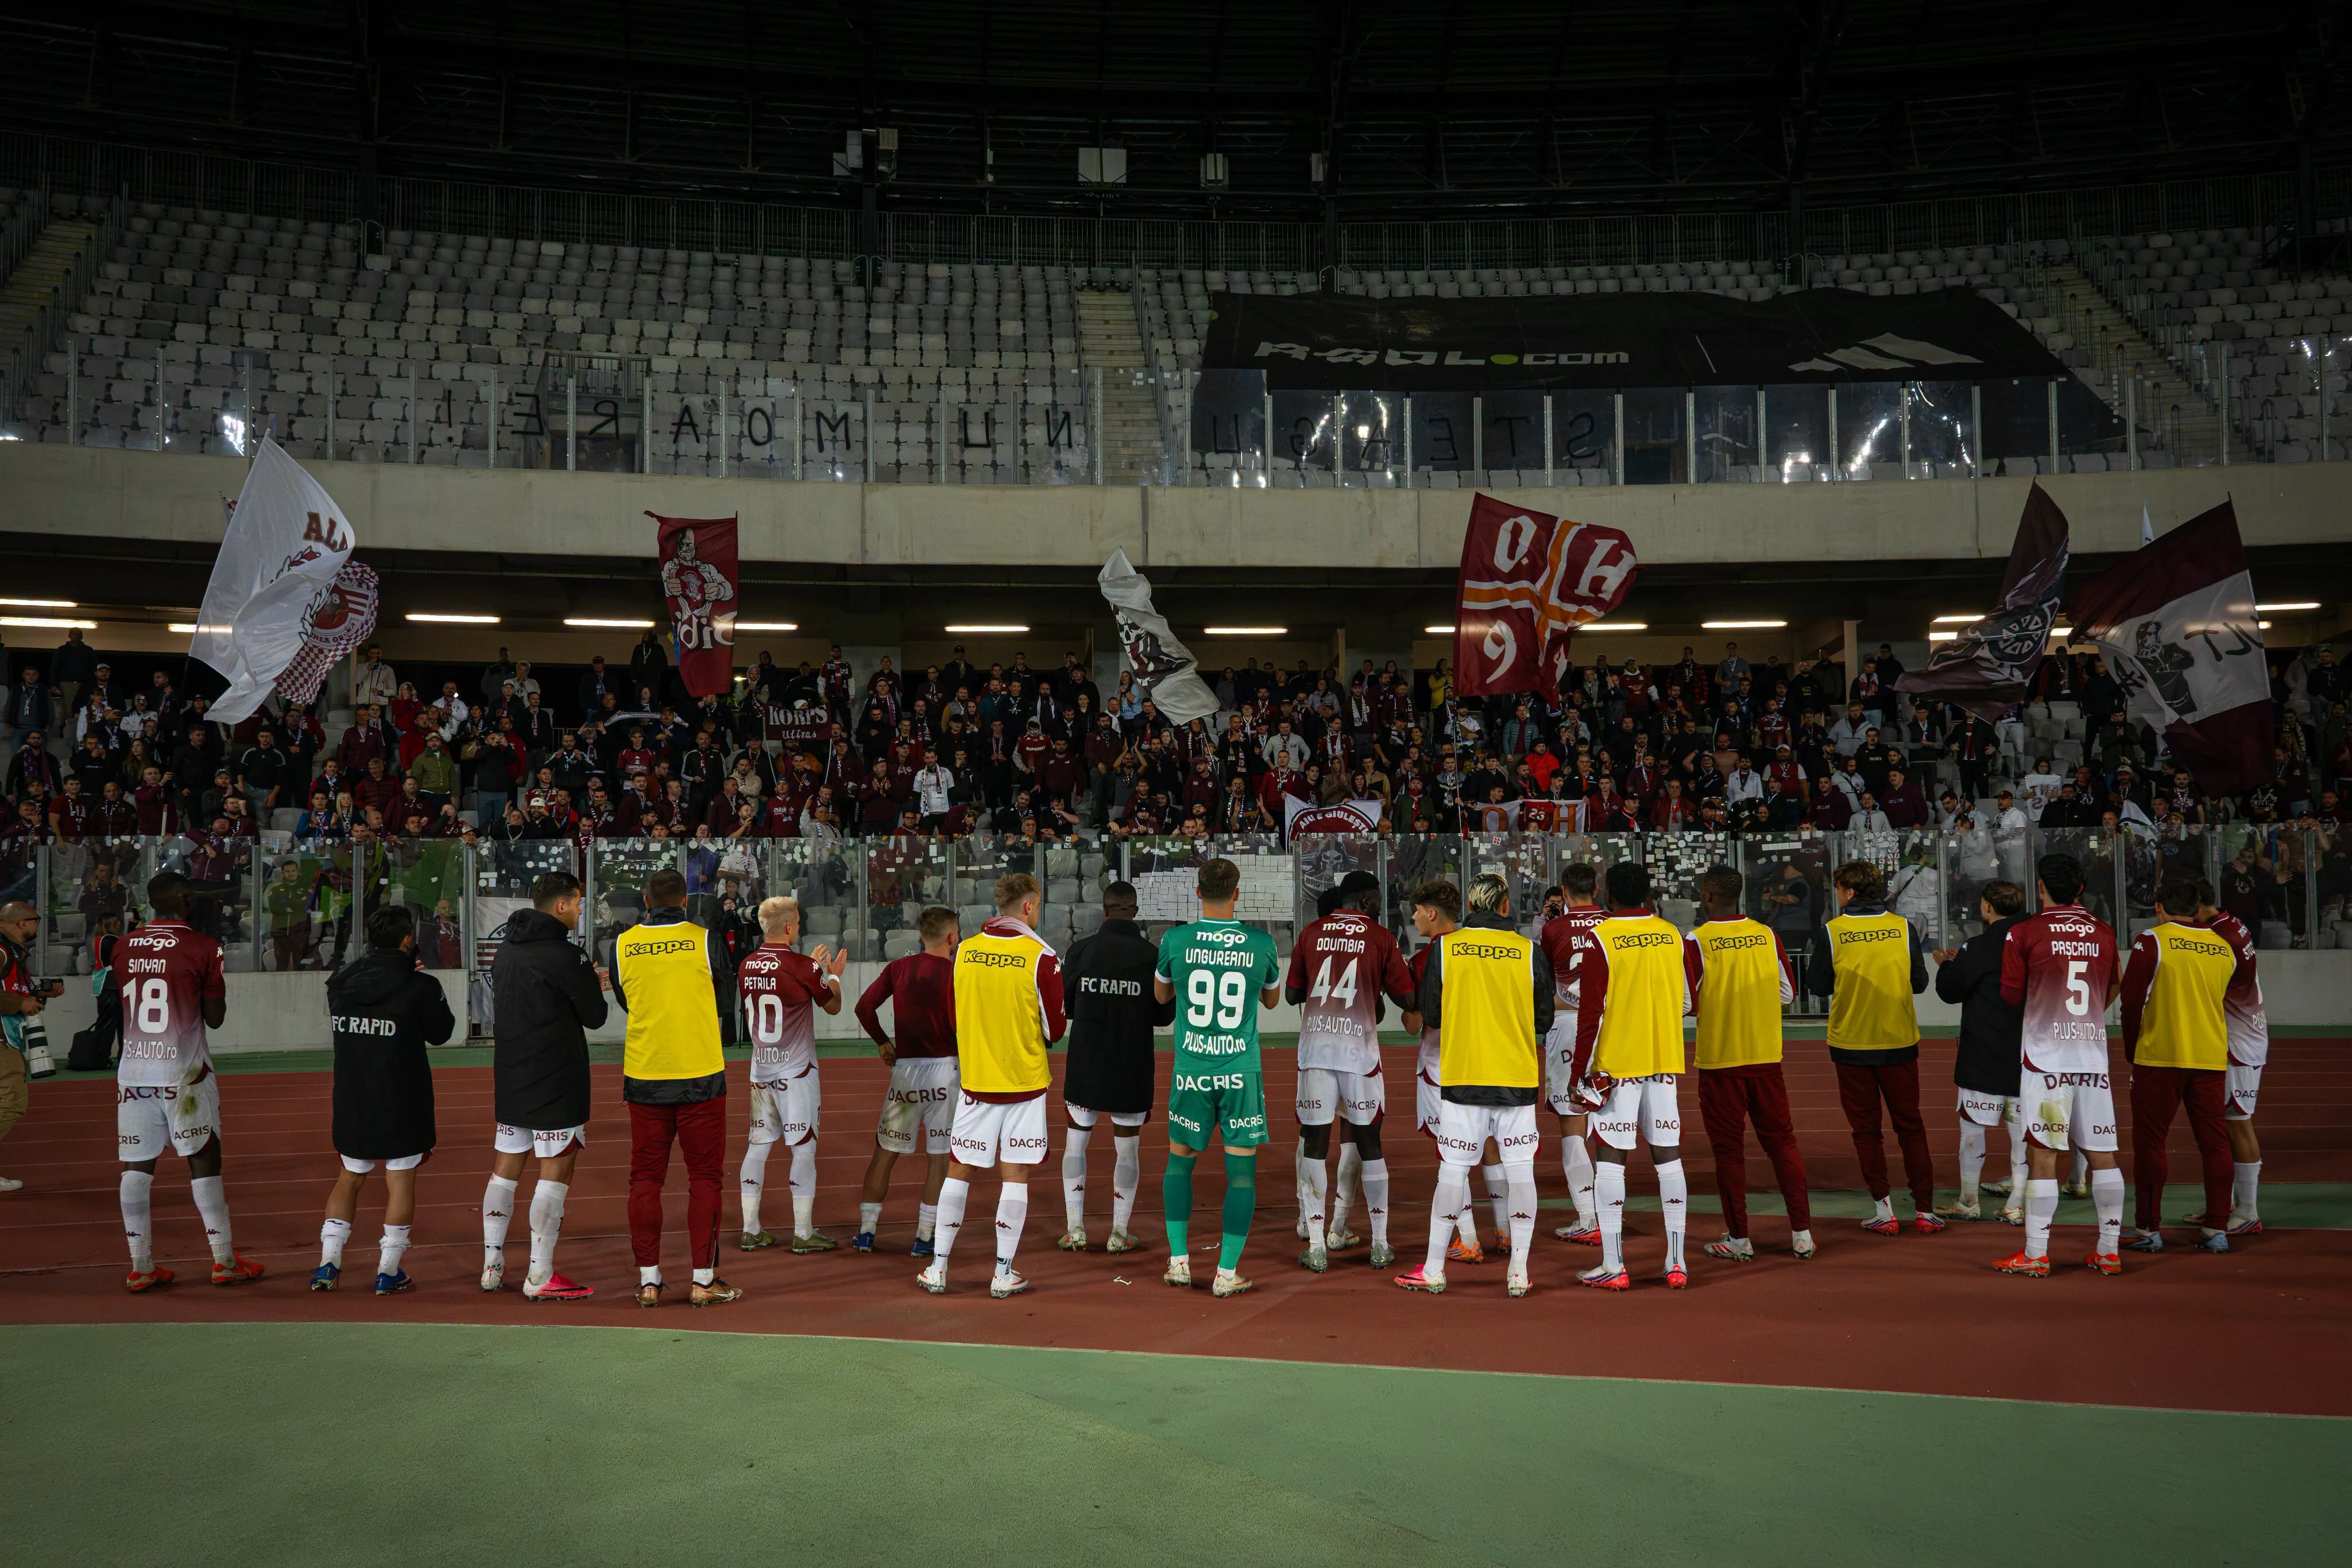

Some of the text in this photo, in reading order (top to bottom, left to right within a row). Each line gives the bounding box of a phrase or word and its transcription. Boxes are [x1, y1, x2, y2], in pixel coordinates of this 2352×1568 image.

[768, 704, 828, 725] KORPS
[1527, 808, 1545, 821] 23
[1322, 922, 1366, 936] mogo
[1840, 929, 1901, 944] Kappa
[2049, 923, 2095, 937] mogo
[129, 936, 176, 951] mogo
[1197, 930, 1246, 948] mogo
[1316, 938, 1365, 954] DOUMBIA
[1612, 933, 1674, 950] Kappa
[1709, 935, 1767, 951] Kappa
[2169, 938, 2230, 957] Kappa
[625, 940, 695, 957] Kappa
[1452, 942, 1522, 959] Kappa
[2051, 940, 2099, 959] PAȘCANU
[129, 958, 166, 974] SINYAN
[745, 960, 779, 973] mogo
[964, 950, 1026, 968] Kappa
[1186, 948, 1254, 968] UNGUREANU
[744, 976, 776, 990] PETRILA
[1081, 977, 1142, 996] FC RAPID
[1310, 955, 1357, 1009] 44
[2065, 961, 2090, 1016] 5
[123, 977, 169, 1033] 18
[1187, 969, 1246, 1029] 99
[331, 1015, 396, 1036] FC RAPID
[745, 993, 783, 1043] 10
[1306, 1015, 1364, 1037] PLUS-AUTO.ro
[1182, 1031, 1246, 1055] PLUS-AUTO.ro
[1176, 1073, 1244, 1091] DACRIS
[888, 1087, 947, 1104] DACRIS
[1348, 1099, 1376, 1110] DACRIS
[1966, 1100, 2003, 1112] DACRIS
[1169, 1110, 1201, 1132] DACRIS
[1229, 1114, 1263, 1129] DACRIS
[1600, 1122, 1638, 1132] DACRIS
[879, 1126, 911, 1141] DACRIS
[951, 1136, 987, 1151] DACRIS
[1438, 1134, 1478, 1152] DACRIS
